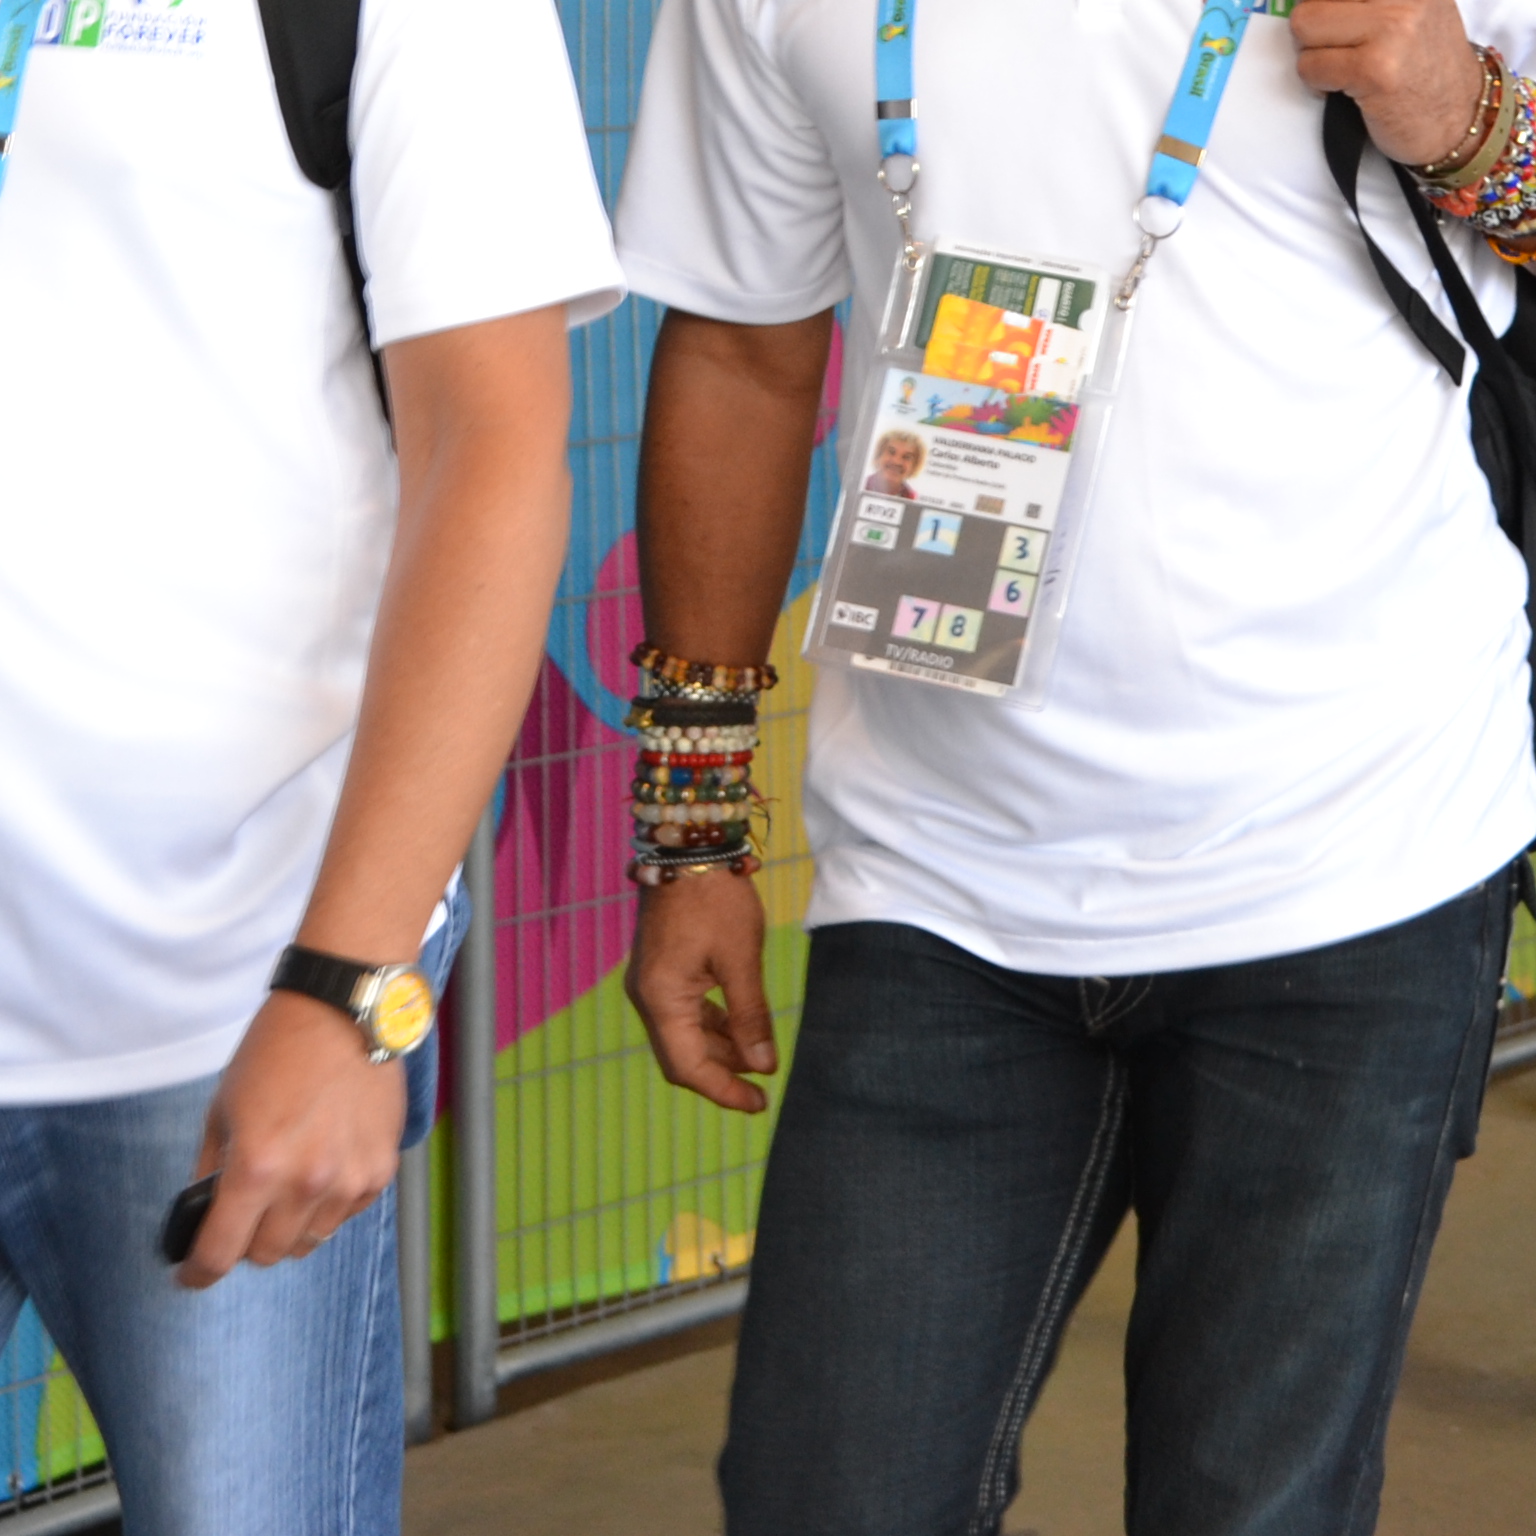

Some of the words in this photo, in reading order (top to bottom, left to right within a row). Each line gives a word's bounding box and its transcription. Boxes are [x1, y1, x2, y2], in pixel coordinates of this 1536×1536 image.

[105, 23, 207, 45] FOREVER
[931, 519, 942, 541] 1
[1015, 536, 1030, 560] 3
[1006, 580, 1021, 603] 6
[912, 606, 928, 629] 7
[950, 615, 968, 638] 8
[885, 642, 955, 670] TV/RADIO
